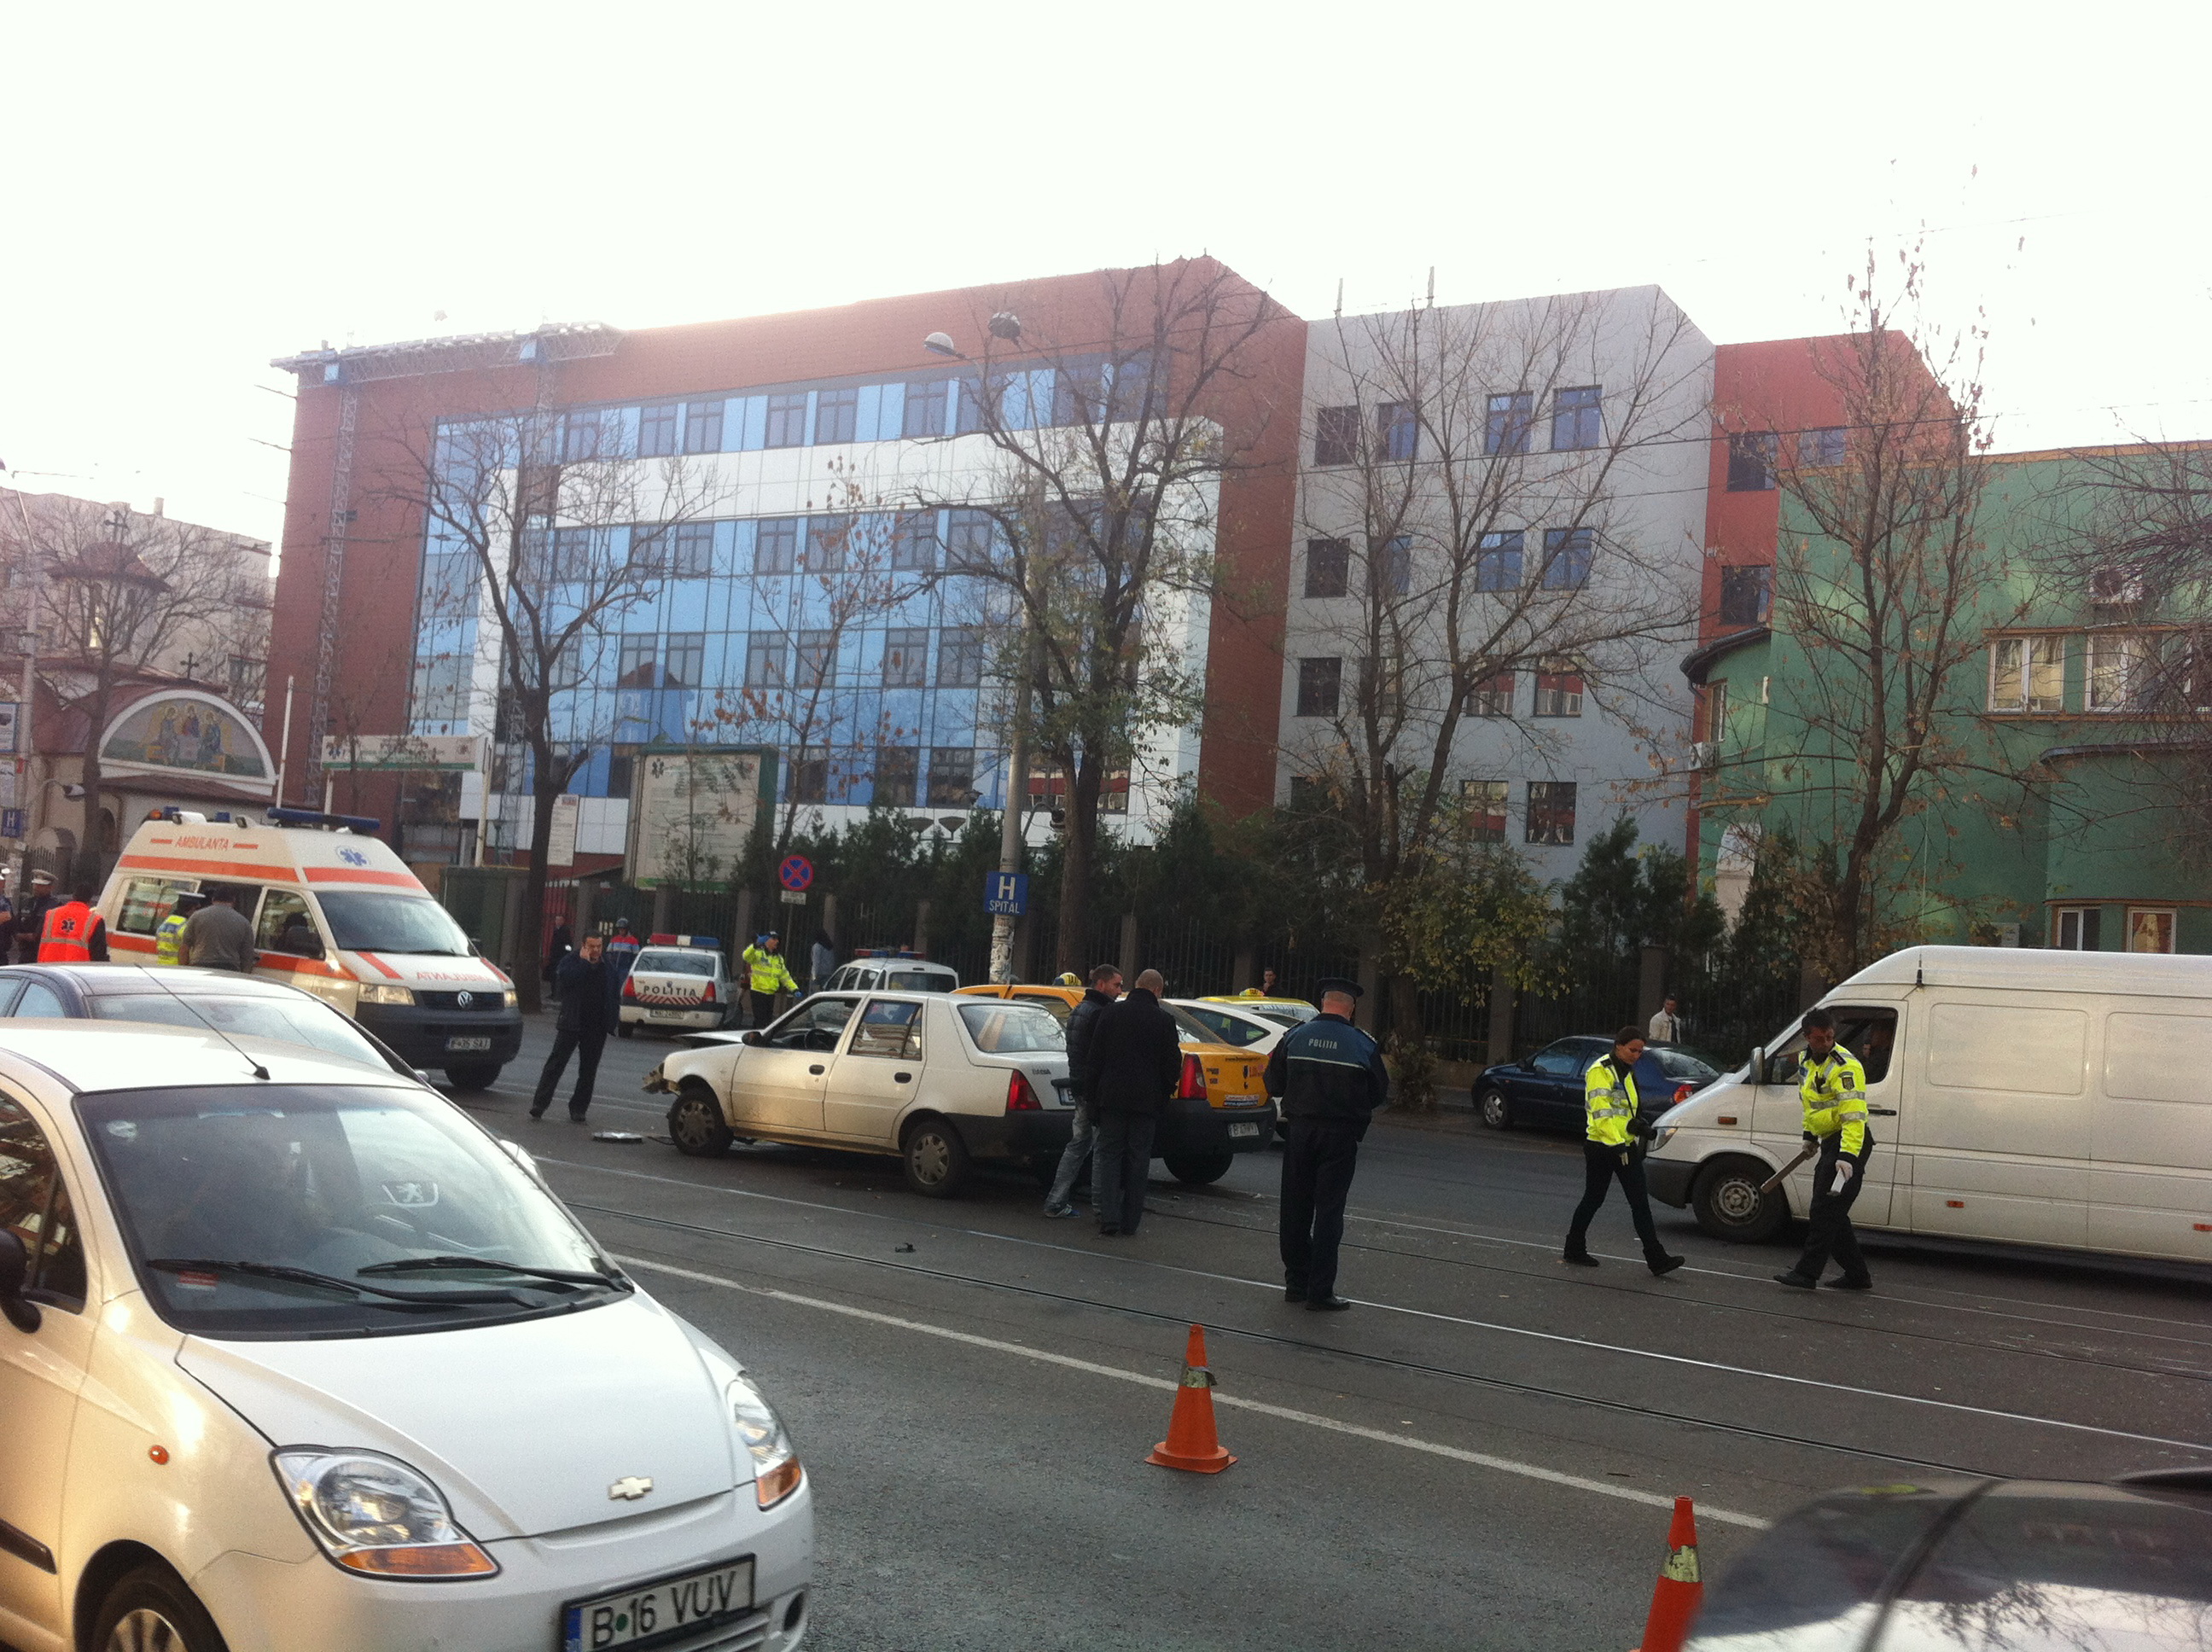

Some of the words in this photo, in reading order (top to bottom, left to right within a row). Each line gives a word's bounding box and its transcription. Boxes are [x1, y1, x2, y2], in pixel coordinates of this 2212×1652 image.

[998, 875, 1016, 900] H
[989, 899, 1020, 914] SPITAL
[643, 986, 696, 997] POLITIA
[592, 1606, 614, 1649] B
[629, 1593, 656, 1637] 16
[671, 1570, 736, 1623] VUV
